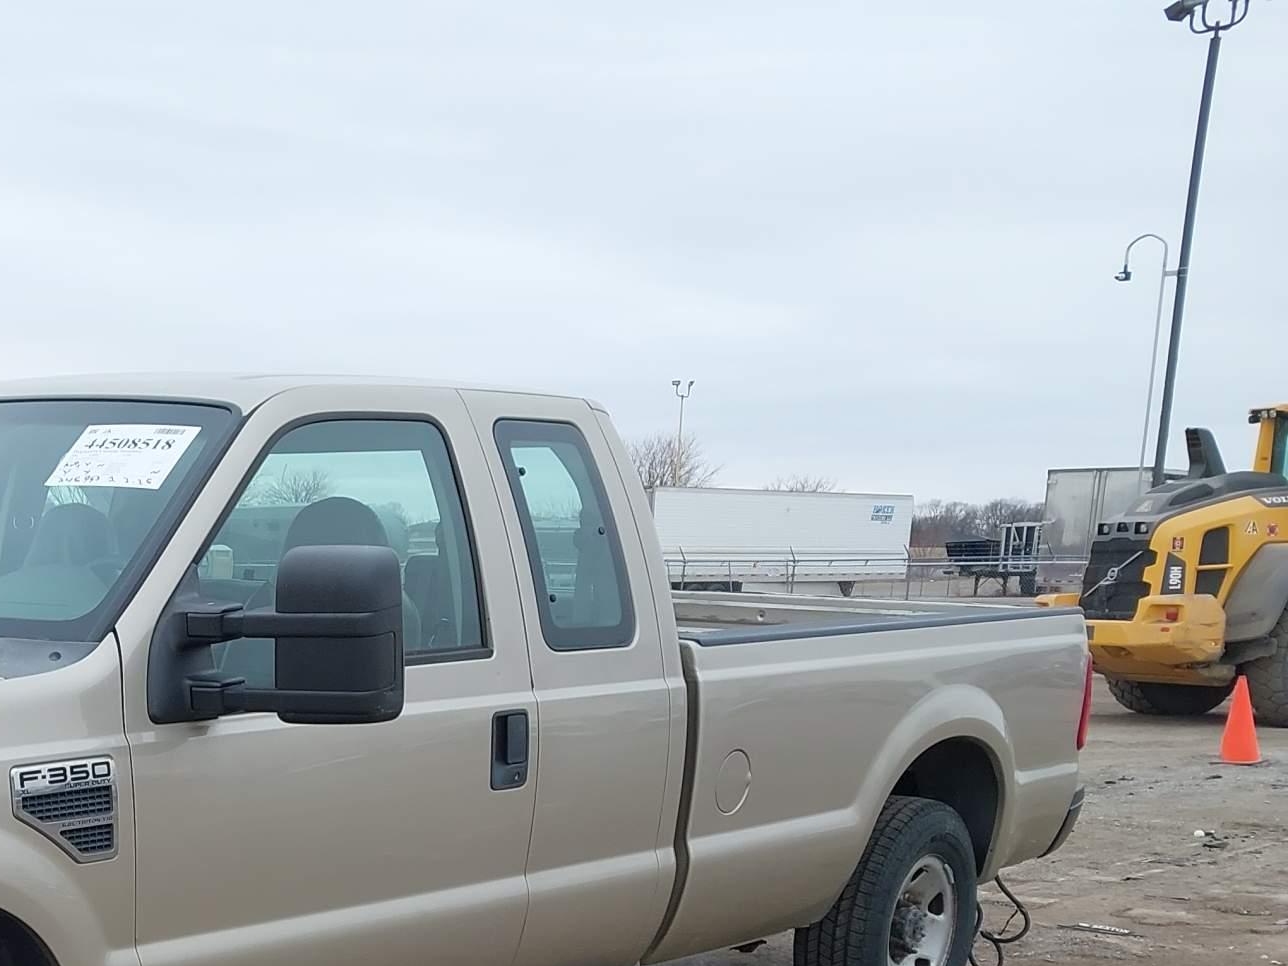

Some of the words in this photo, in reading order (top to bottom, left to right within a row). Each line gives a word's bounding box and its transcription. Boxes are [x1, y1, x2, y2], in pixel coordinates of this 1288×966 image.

[84, 438, 176, 450] 44508518
[1261, 495, 1288, 504] VOL
[1168, 566, 1183, 590] L90H
[19, 761, 111, 788] F-350
[92, 778, 112, 786] DUTY
